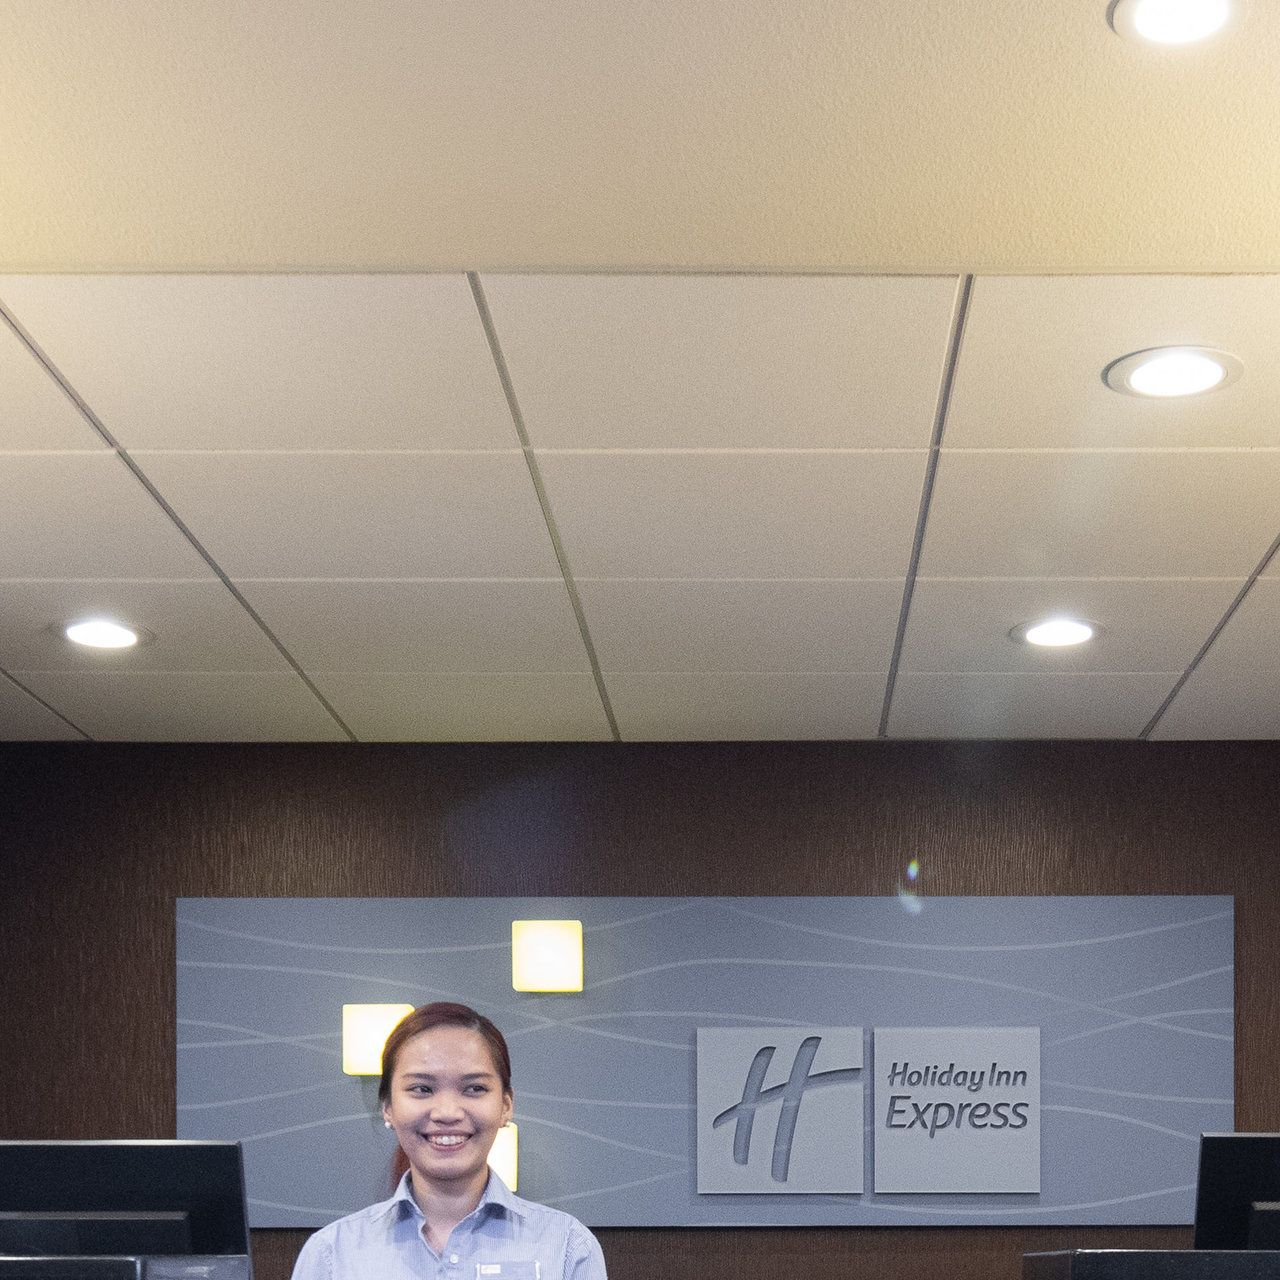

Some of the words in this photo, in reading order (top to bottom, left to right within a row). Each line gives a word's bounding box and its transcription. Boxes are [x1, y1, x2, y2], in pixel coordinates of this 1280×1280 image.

[888, 1062, 985, 1092] Holiday
[988, 1062, 1027, 1086] Inn
[886, 1095, 1029, 1139] Express
